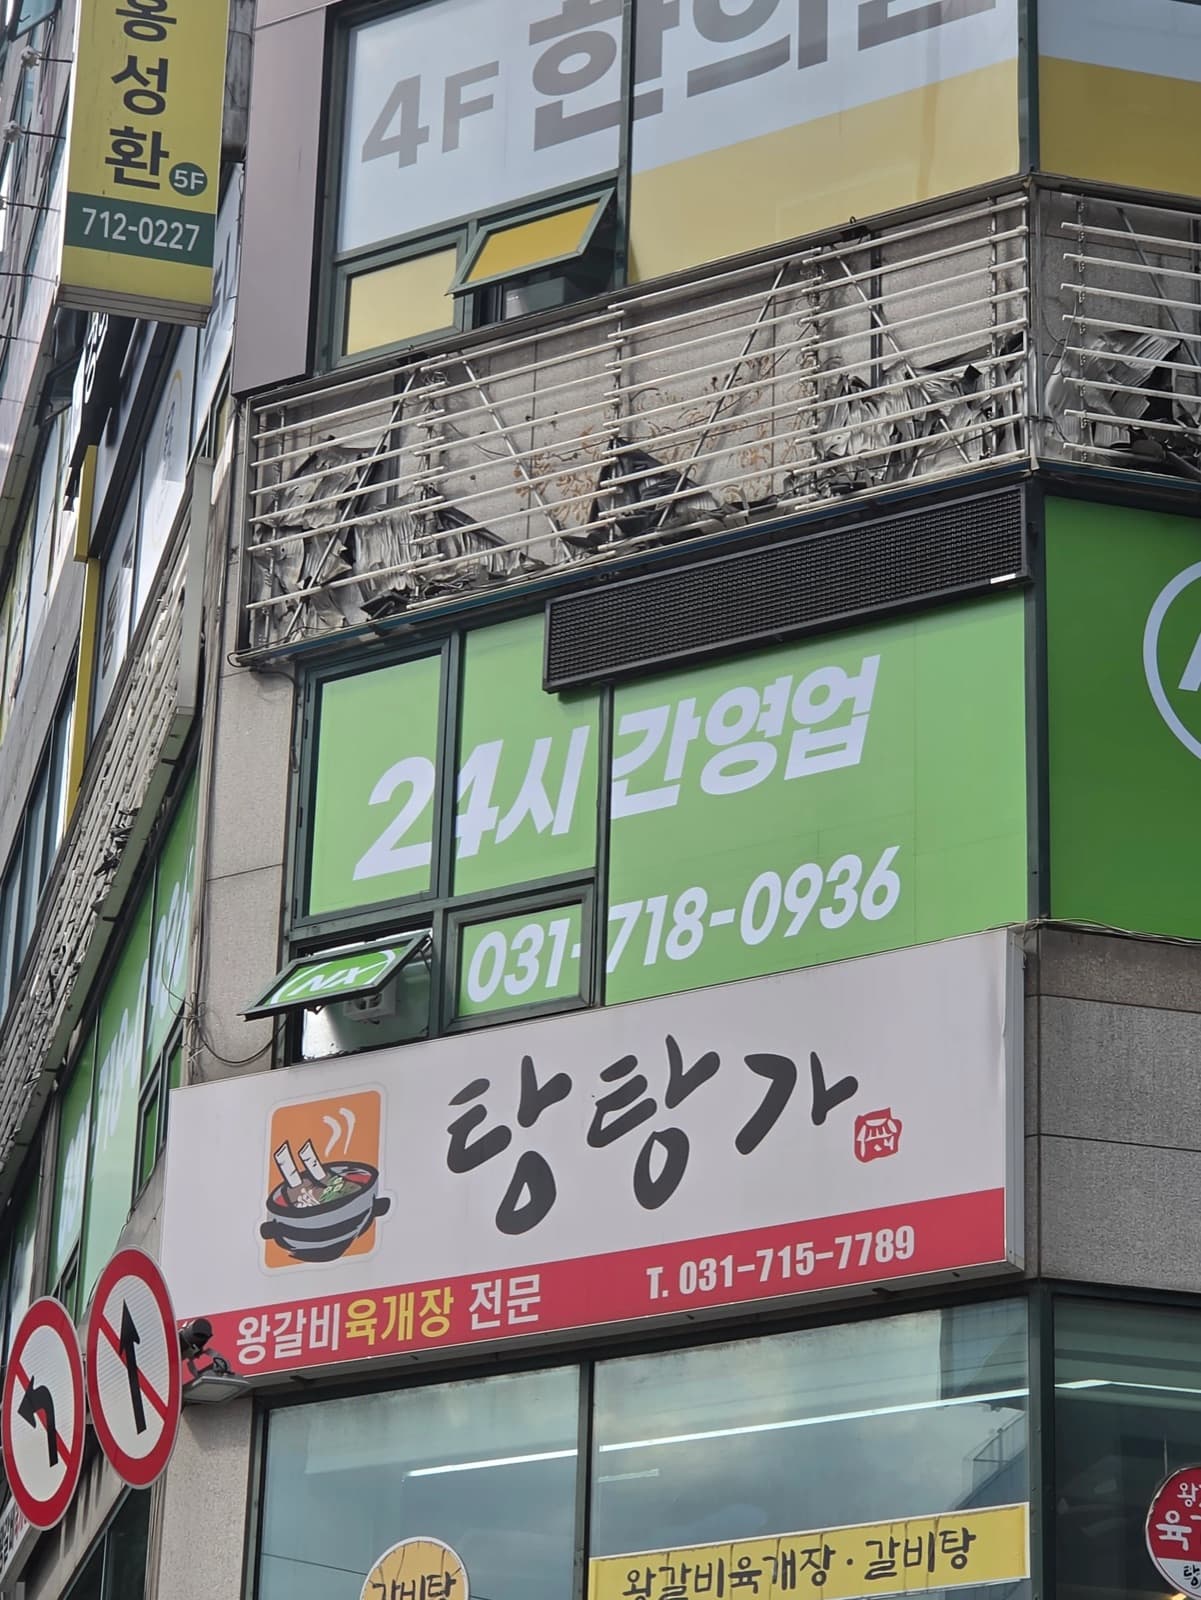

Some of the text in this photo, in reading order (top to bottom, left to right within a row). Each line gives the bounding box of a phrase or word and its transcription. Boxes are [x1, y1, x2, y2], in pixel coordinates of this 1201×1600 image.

[361, 60, 500, 169] 4F
[529, 0, 998, 152] 한의
[173, 169, 205, 190] 5F
[82, 207, 201, 252] 712-0227
[352, 655, 881, 881] 24시간영업
[467, 845, 901, 1004] 031-718-0936
[447, 1034, 859, 1235] 탕탕가
[646, 1225, 915, 1300] T. 031-715-7789
[236, 1273, 541, 1366] 왕갈비육개장 전문
[1155, 1509, 1201, 1552] 육
[1177, 1482, 1201, 1508] 왕
[864, 1527, 977, 1580] 갈비탕
